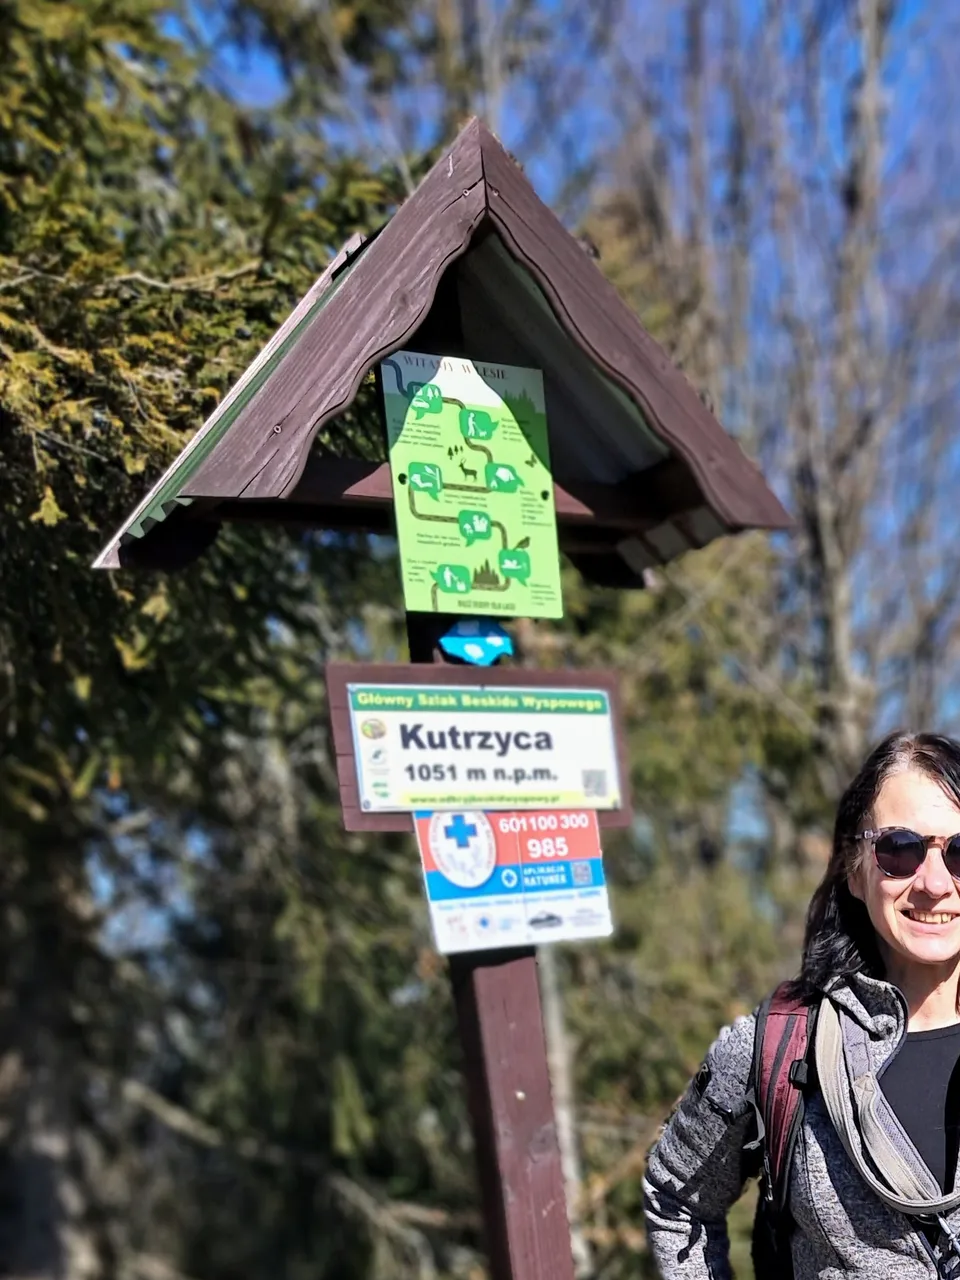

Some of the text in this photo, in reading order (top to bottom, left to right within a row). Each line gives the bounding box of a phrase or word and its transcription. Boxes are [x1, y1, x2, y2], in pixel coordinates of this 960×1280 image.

[357, 692, 602, 712] Główny Szlak Beskidu Wyspowego
[399, 723, 553, 758] Kutrzyca
[405, 764, 458, 781] 1051
[467, 767, 487, 781] m
[494, 767, 558, 784] n.p.m.
[499, 812, 589, 833] 601 100 300
[527, 835, 569, 858] 985
